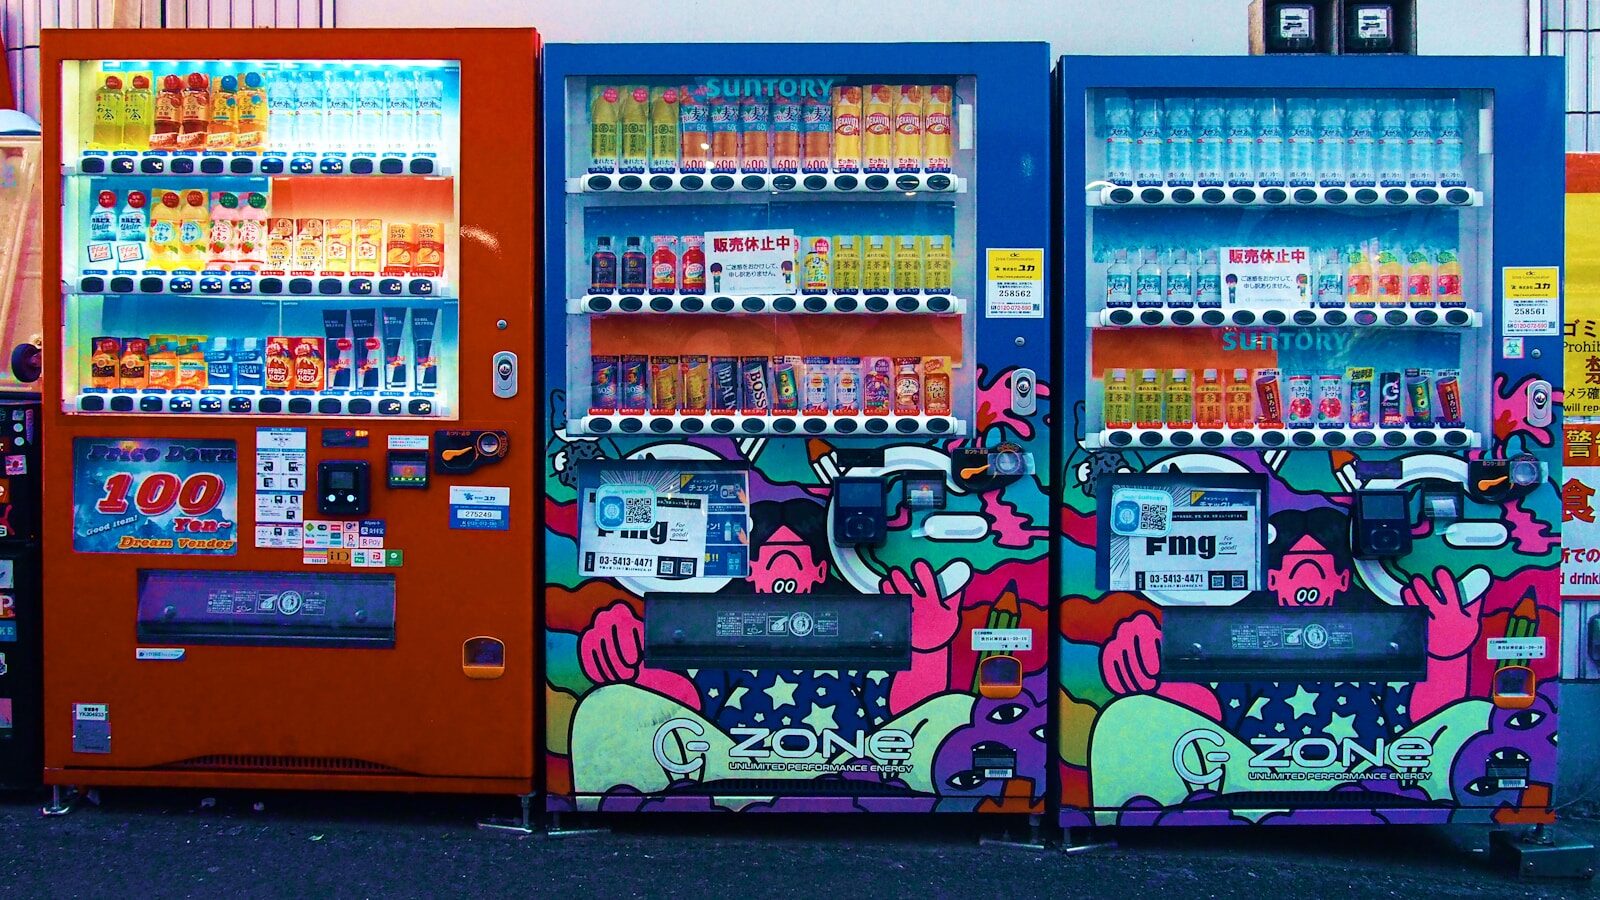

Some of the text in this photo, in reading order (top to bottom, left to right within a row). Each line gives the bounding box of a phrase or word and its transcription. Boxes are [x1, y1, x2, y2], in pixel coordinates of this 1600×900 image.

[685, 160, 704, 168] 600
[716, 160, 735, 168] 600
[746, 160, 765, 168] 600
[778, 160, 797, 168] 600
[807, 160, 826, 168] 600
[713, 235, 790, 253] 販売休止中
[1228, 248, 1306, 264] 販売休止中
[725, 263, 779, 271] ご迷惑をおかけして、
[717, 365, 736, 409] BLACK
[750, 370, 767, 409] BOSS
[95, 471, 226, 517] 100
[1562, 478, 1596, 523] 食
[87, 514, 138, 536] Good item!
[118, 535, 234, 550] Dream Vender
[1146, 535, 1216, 560] Fmg
[599, 556, 653, 567] 03-5413-4471
[1150, 574, 1203, 583] 03-5413-4471
[728, 762, 914, 773] UNLIMITED PERFORMANCE ENERGY
[1248, 772, 1432, 782] UNLIMITED PERFORMANCE ENERGY
